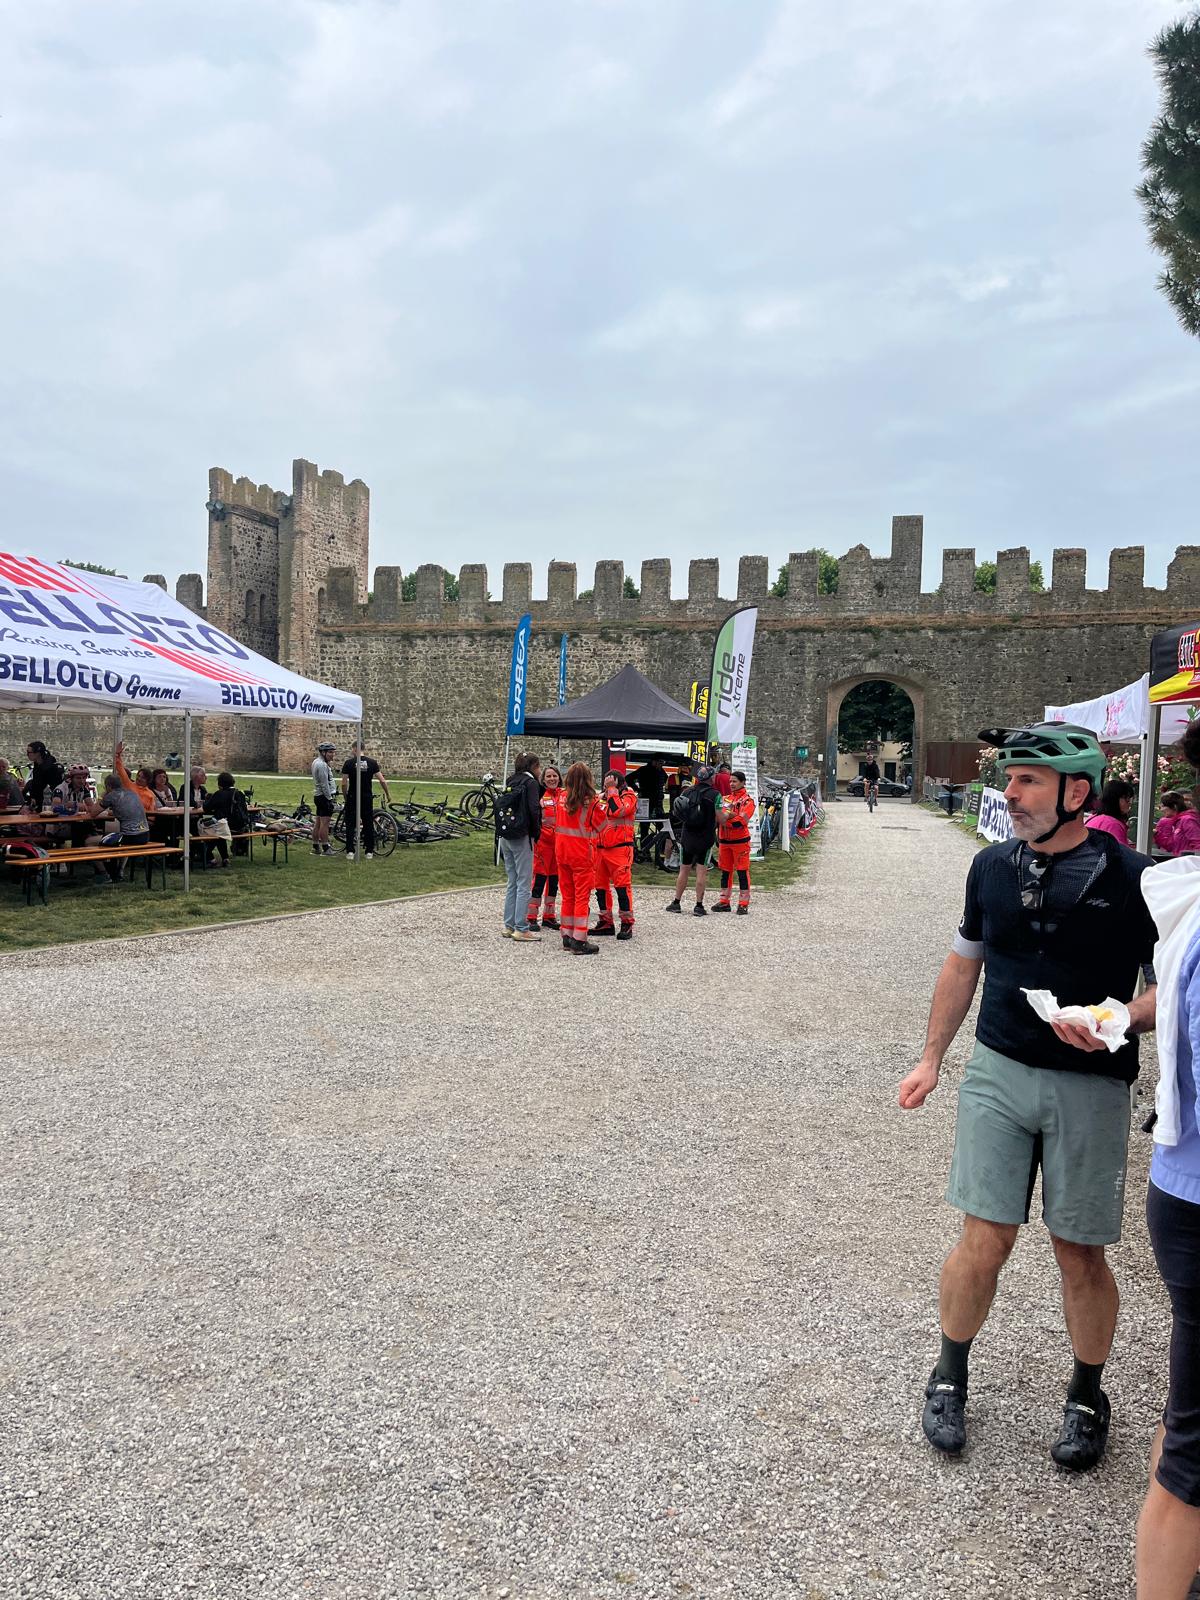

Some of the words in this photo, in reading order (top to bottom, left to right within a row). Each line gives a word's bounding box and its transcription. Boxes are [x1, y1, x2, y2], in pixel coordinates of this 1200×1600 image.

[0, 628, 81, 656] Racing
[81, 640, 156, 659] Service
[0, 653, 123, 693] BELLOTTO
[126, 674, 182, 700] Gomme
[220, 683, 298, 710] BELLOTTO
[300, 693, 335, 714] Gomme
[513, 627, 526, 725] ORBEA
[715, 652, 736, 718] ride
